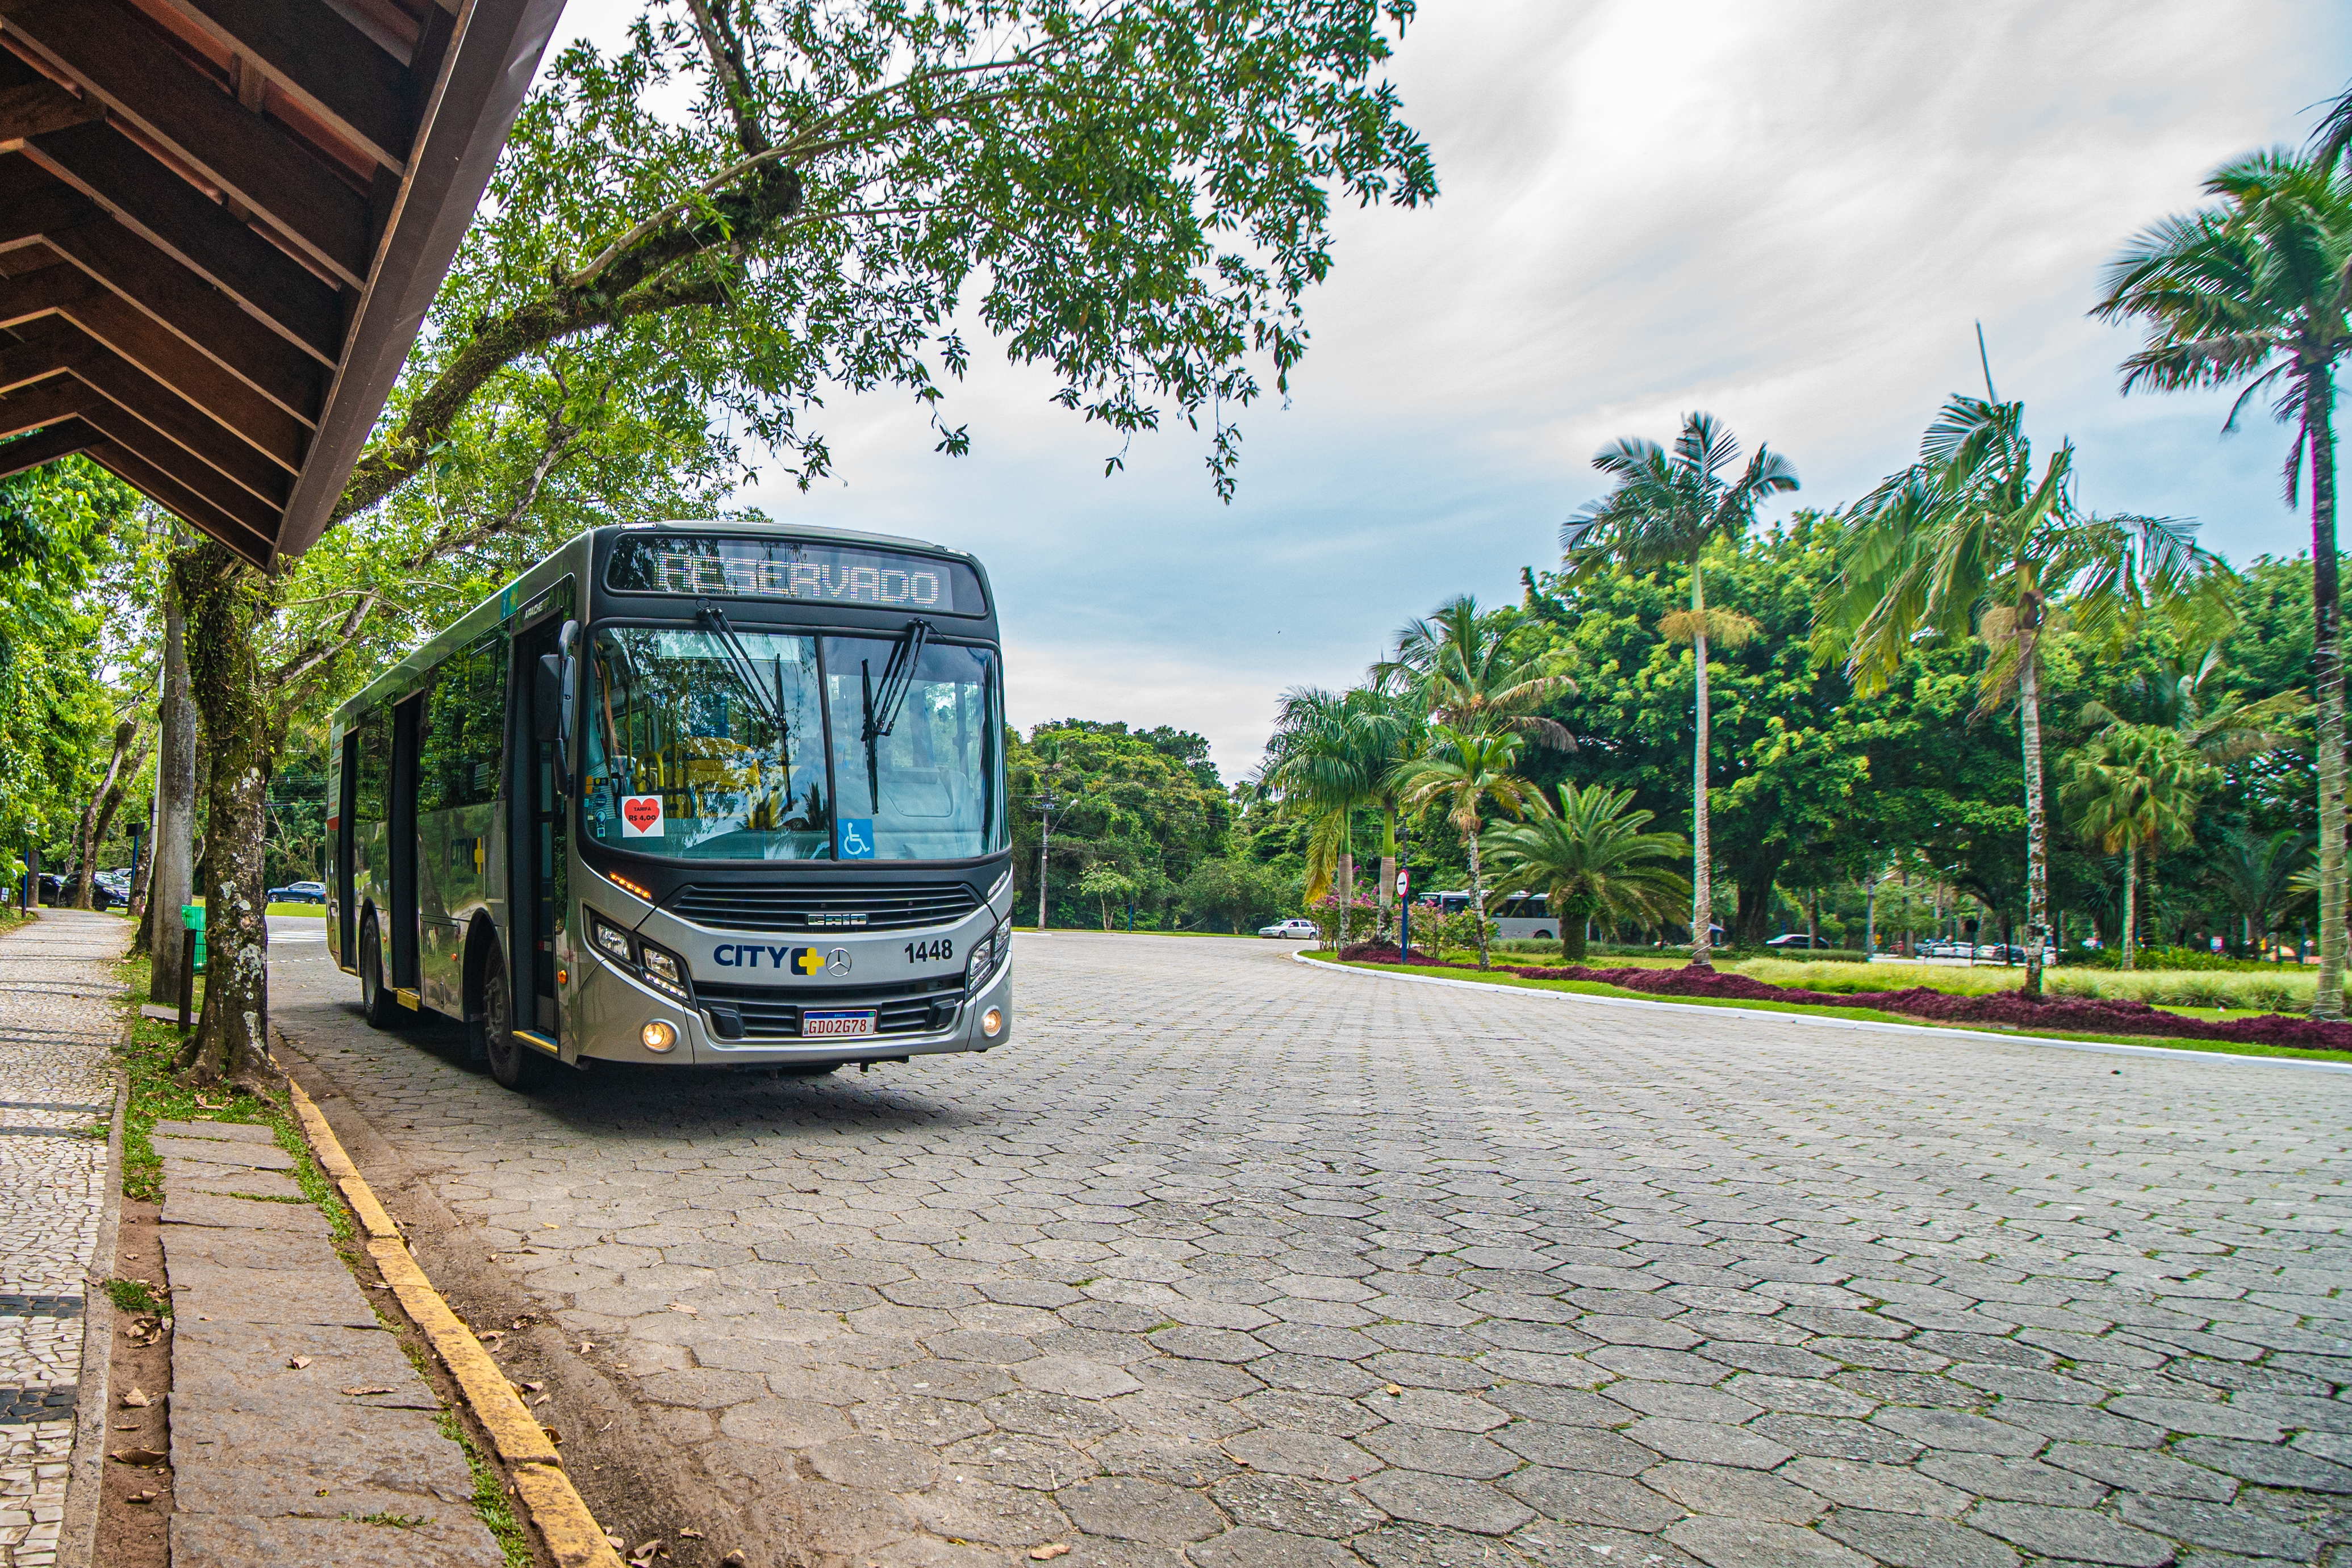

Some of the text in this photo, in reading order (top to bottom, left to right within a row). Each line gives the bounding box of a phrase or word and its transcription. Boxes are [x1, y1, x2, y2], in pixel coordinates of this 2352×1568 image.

[658, 552, 939, 604] RESERVADO
[524, 602, 542, 620] APACHE
[450, 838, 473, 866] CITY
[808, 914, 867, 925] CAIO
[713, 944, 789, 968] CITY
[904, 939, 954, 964] 1448
